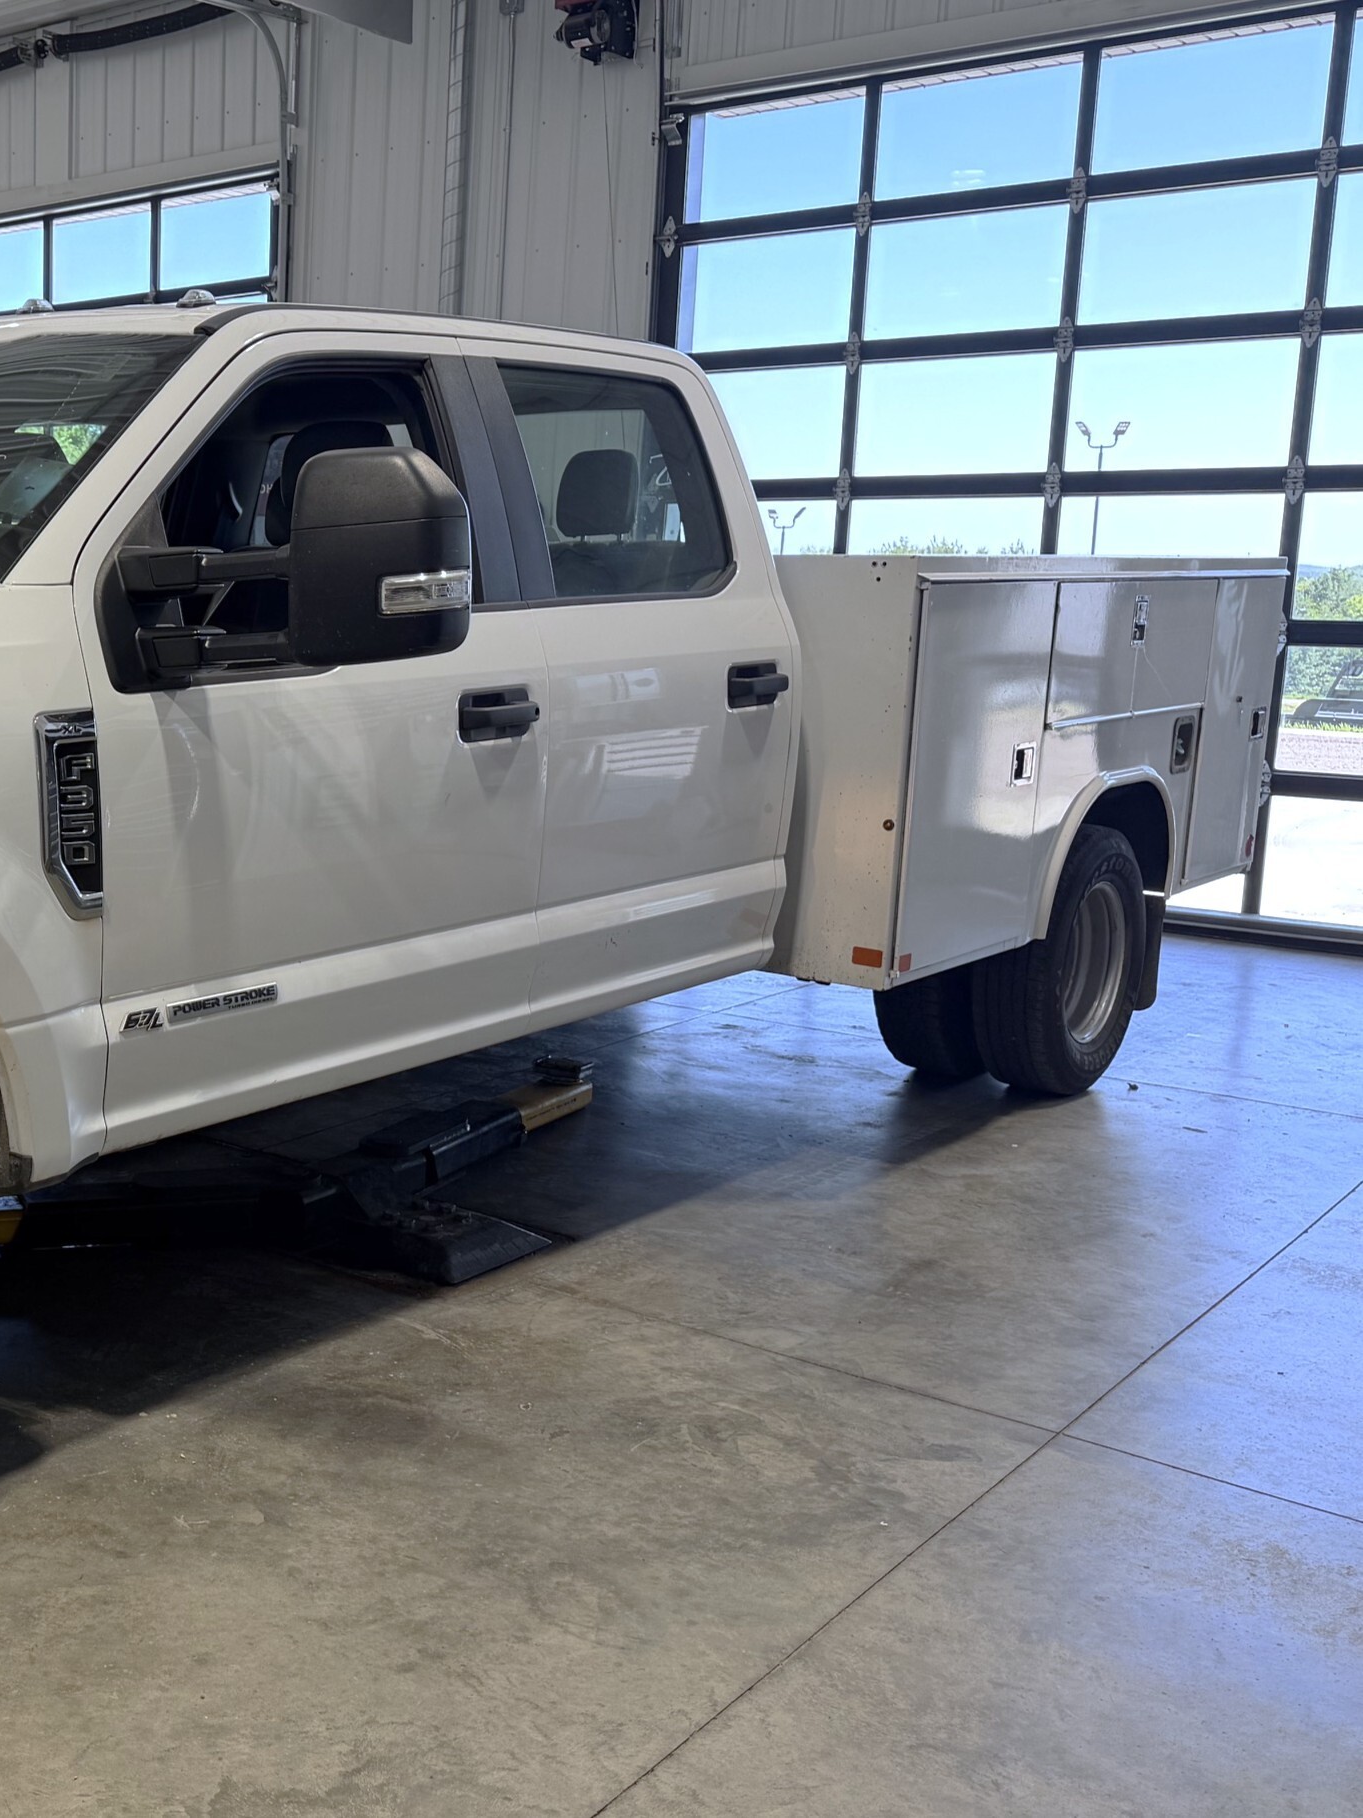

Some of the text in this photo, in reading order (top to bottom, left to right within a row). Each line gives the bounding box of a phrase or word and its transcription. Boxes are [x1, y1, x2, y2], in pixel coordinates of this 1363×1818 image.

[61, 725, 83, 736] XL
[60, 752, 96, 865] F350
[172, 996, 221, 1017] POWER
[222, 985, 276, 1006] STROKE
[228, 996, 275, 1011] TURBO DIESEL
